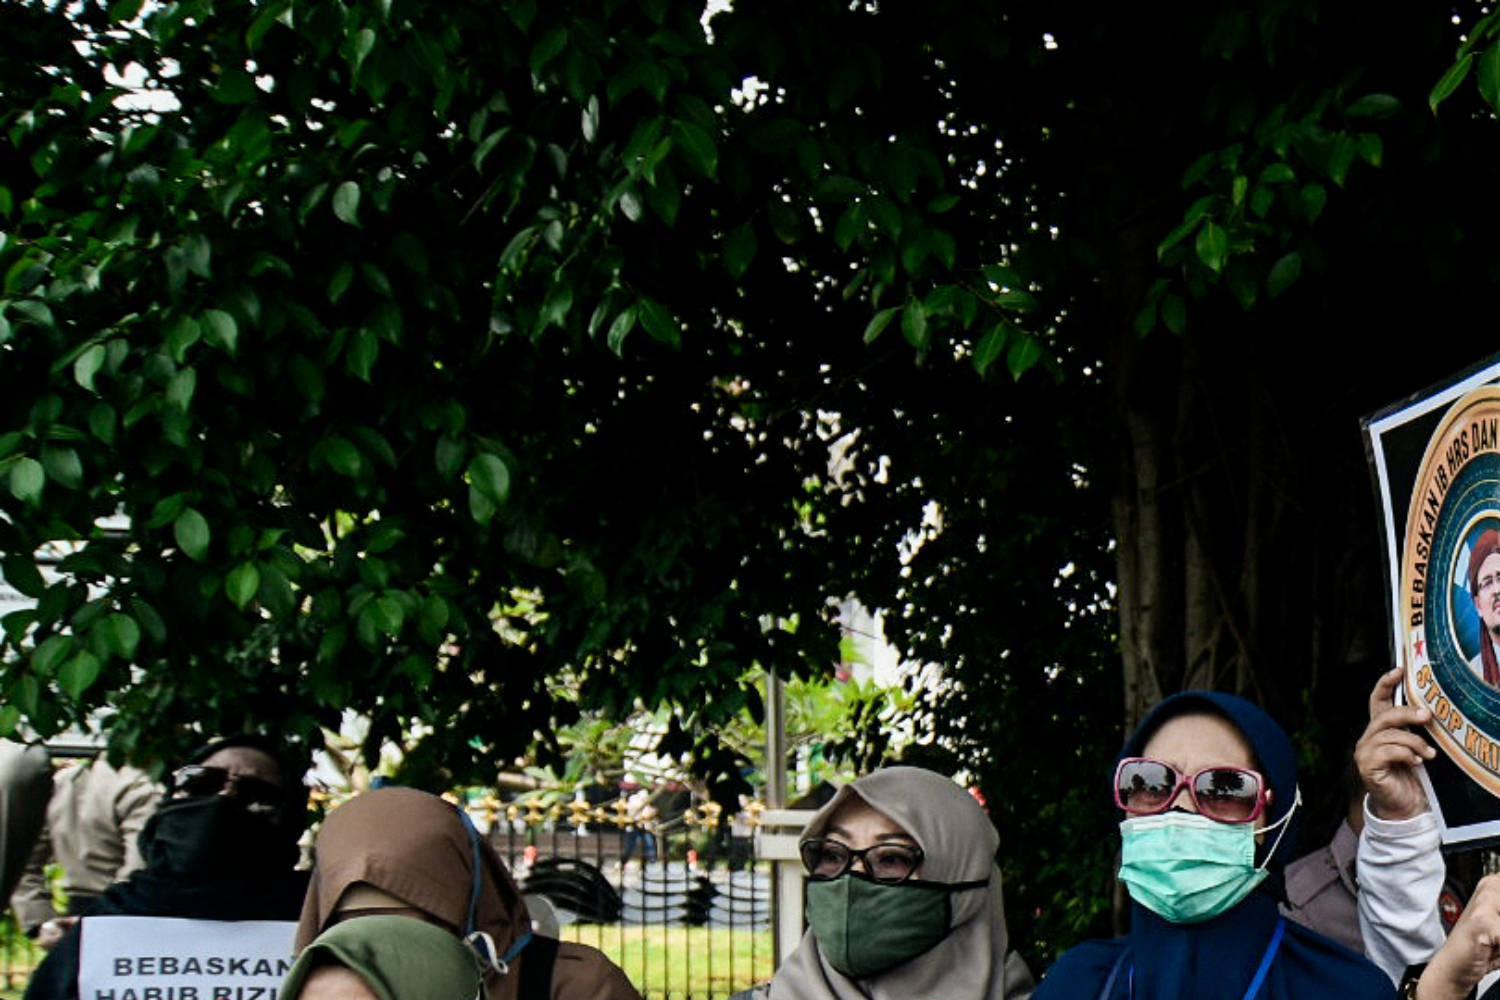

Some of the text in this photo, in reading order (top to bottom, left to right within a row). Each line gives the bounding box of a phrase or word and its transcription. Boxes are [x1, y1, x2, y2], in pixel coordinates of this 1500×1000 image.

[1410, 493, 1441, 627] BEBASKAN
[1447, 434, 1470, 476] HRS
[1471, 420, 1498, 455] DAN
[1416, 664, 1462, 732] STOP
